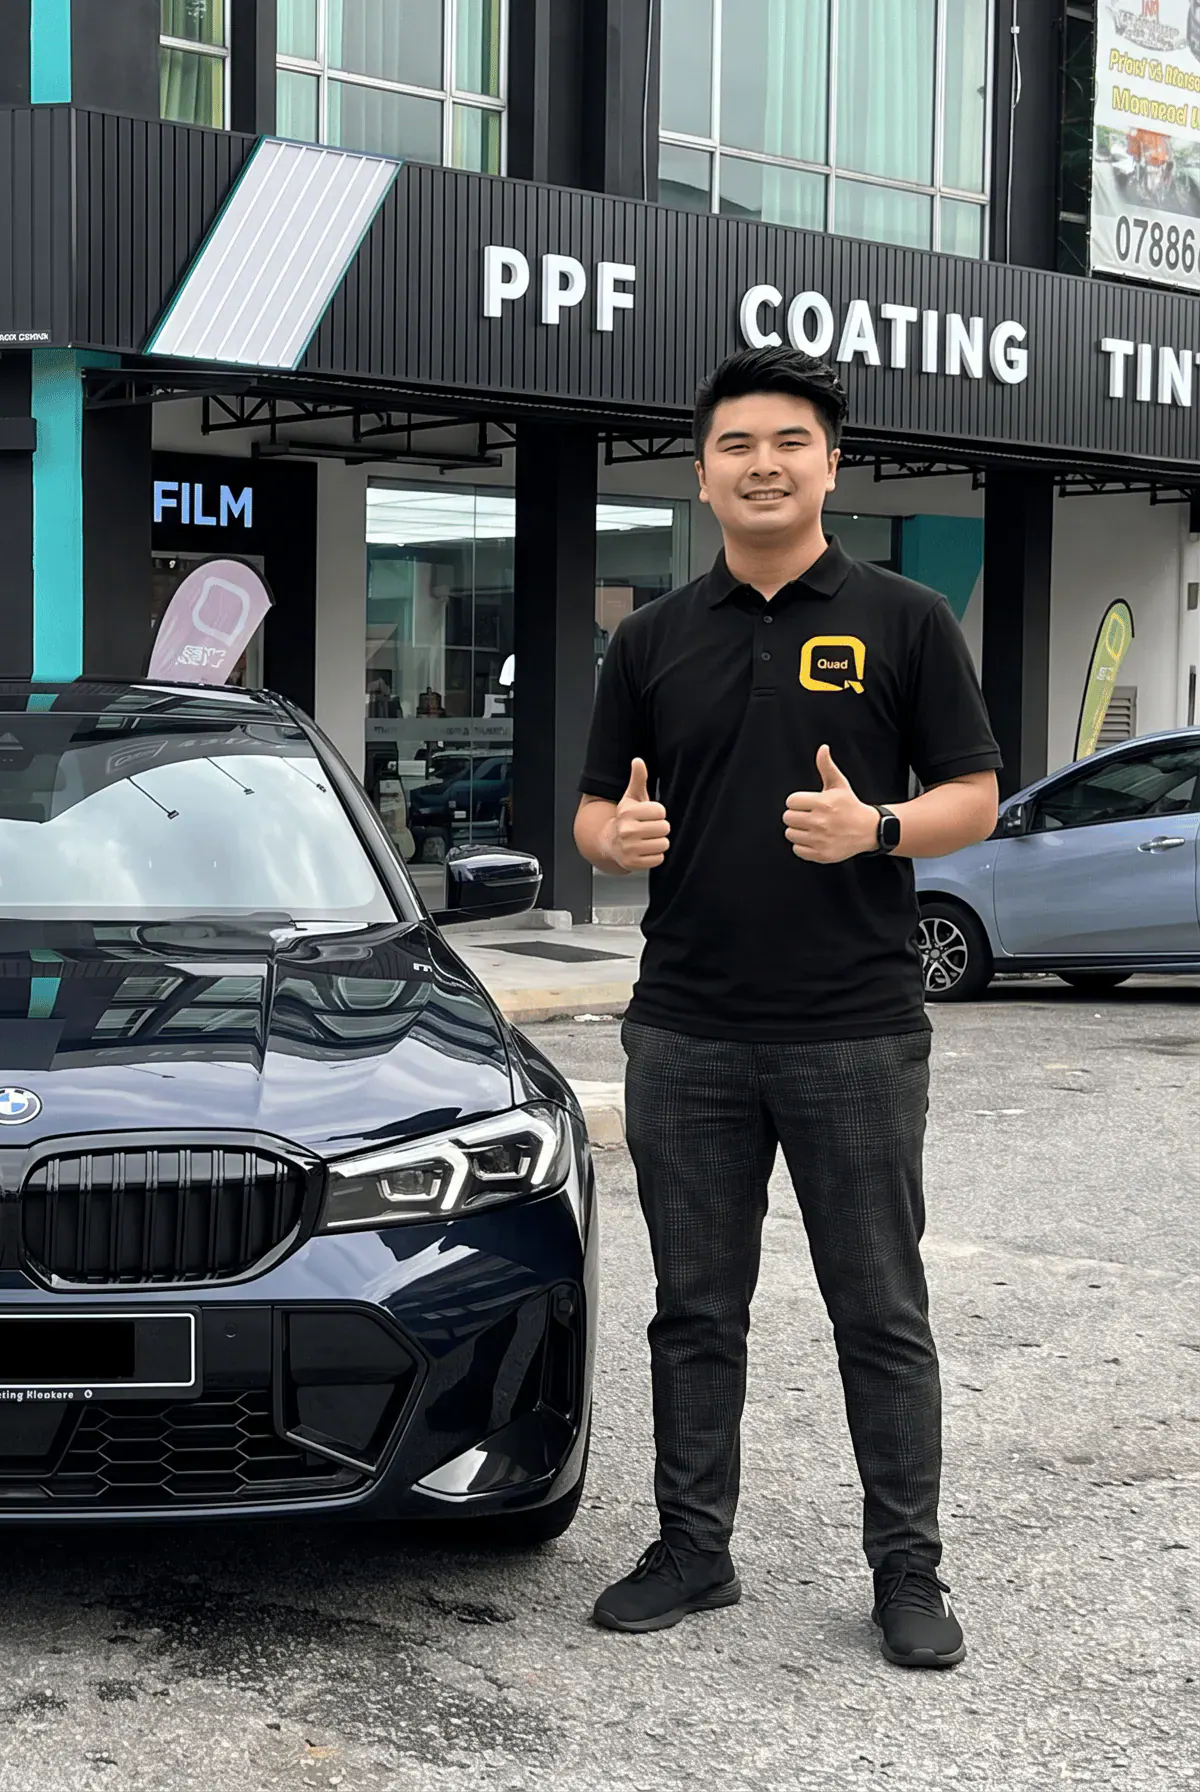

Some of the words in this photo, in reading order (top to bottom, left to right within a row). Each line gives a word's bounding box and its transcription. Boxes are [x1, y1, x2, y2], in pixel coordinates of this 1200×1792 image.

[1116, 216, 1200, 274] 07886
[484, 245, 636, 331] PPF
[740, 284, 1029, 385] COATING
[1101, 338, 1200, 408] TIN
[153, 480, 253, 528] FILM
[817, 658, 849, 670] Quad
